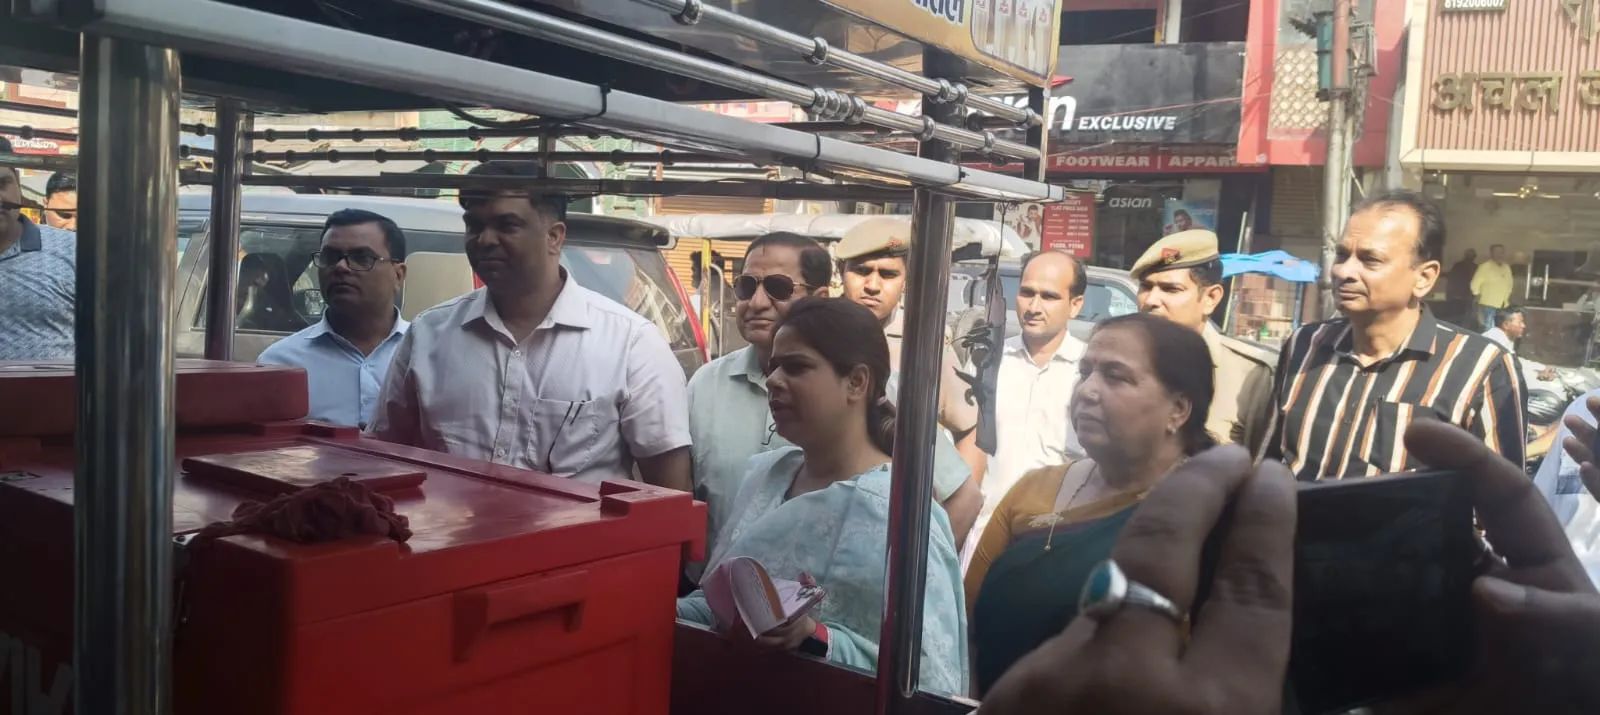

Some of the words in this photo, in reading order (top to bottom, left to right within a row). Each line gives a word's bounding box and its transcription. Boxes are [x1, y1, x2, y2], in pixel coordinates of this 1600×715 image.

[1432, 72, 1563, 110] अचल
[1079, 116, 1176, 130] EXCLUSIVE
[1056, 156, 1149, 167] FOOTWEAR
[1108, 197, 1152, 208] asian
